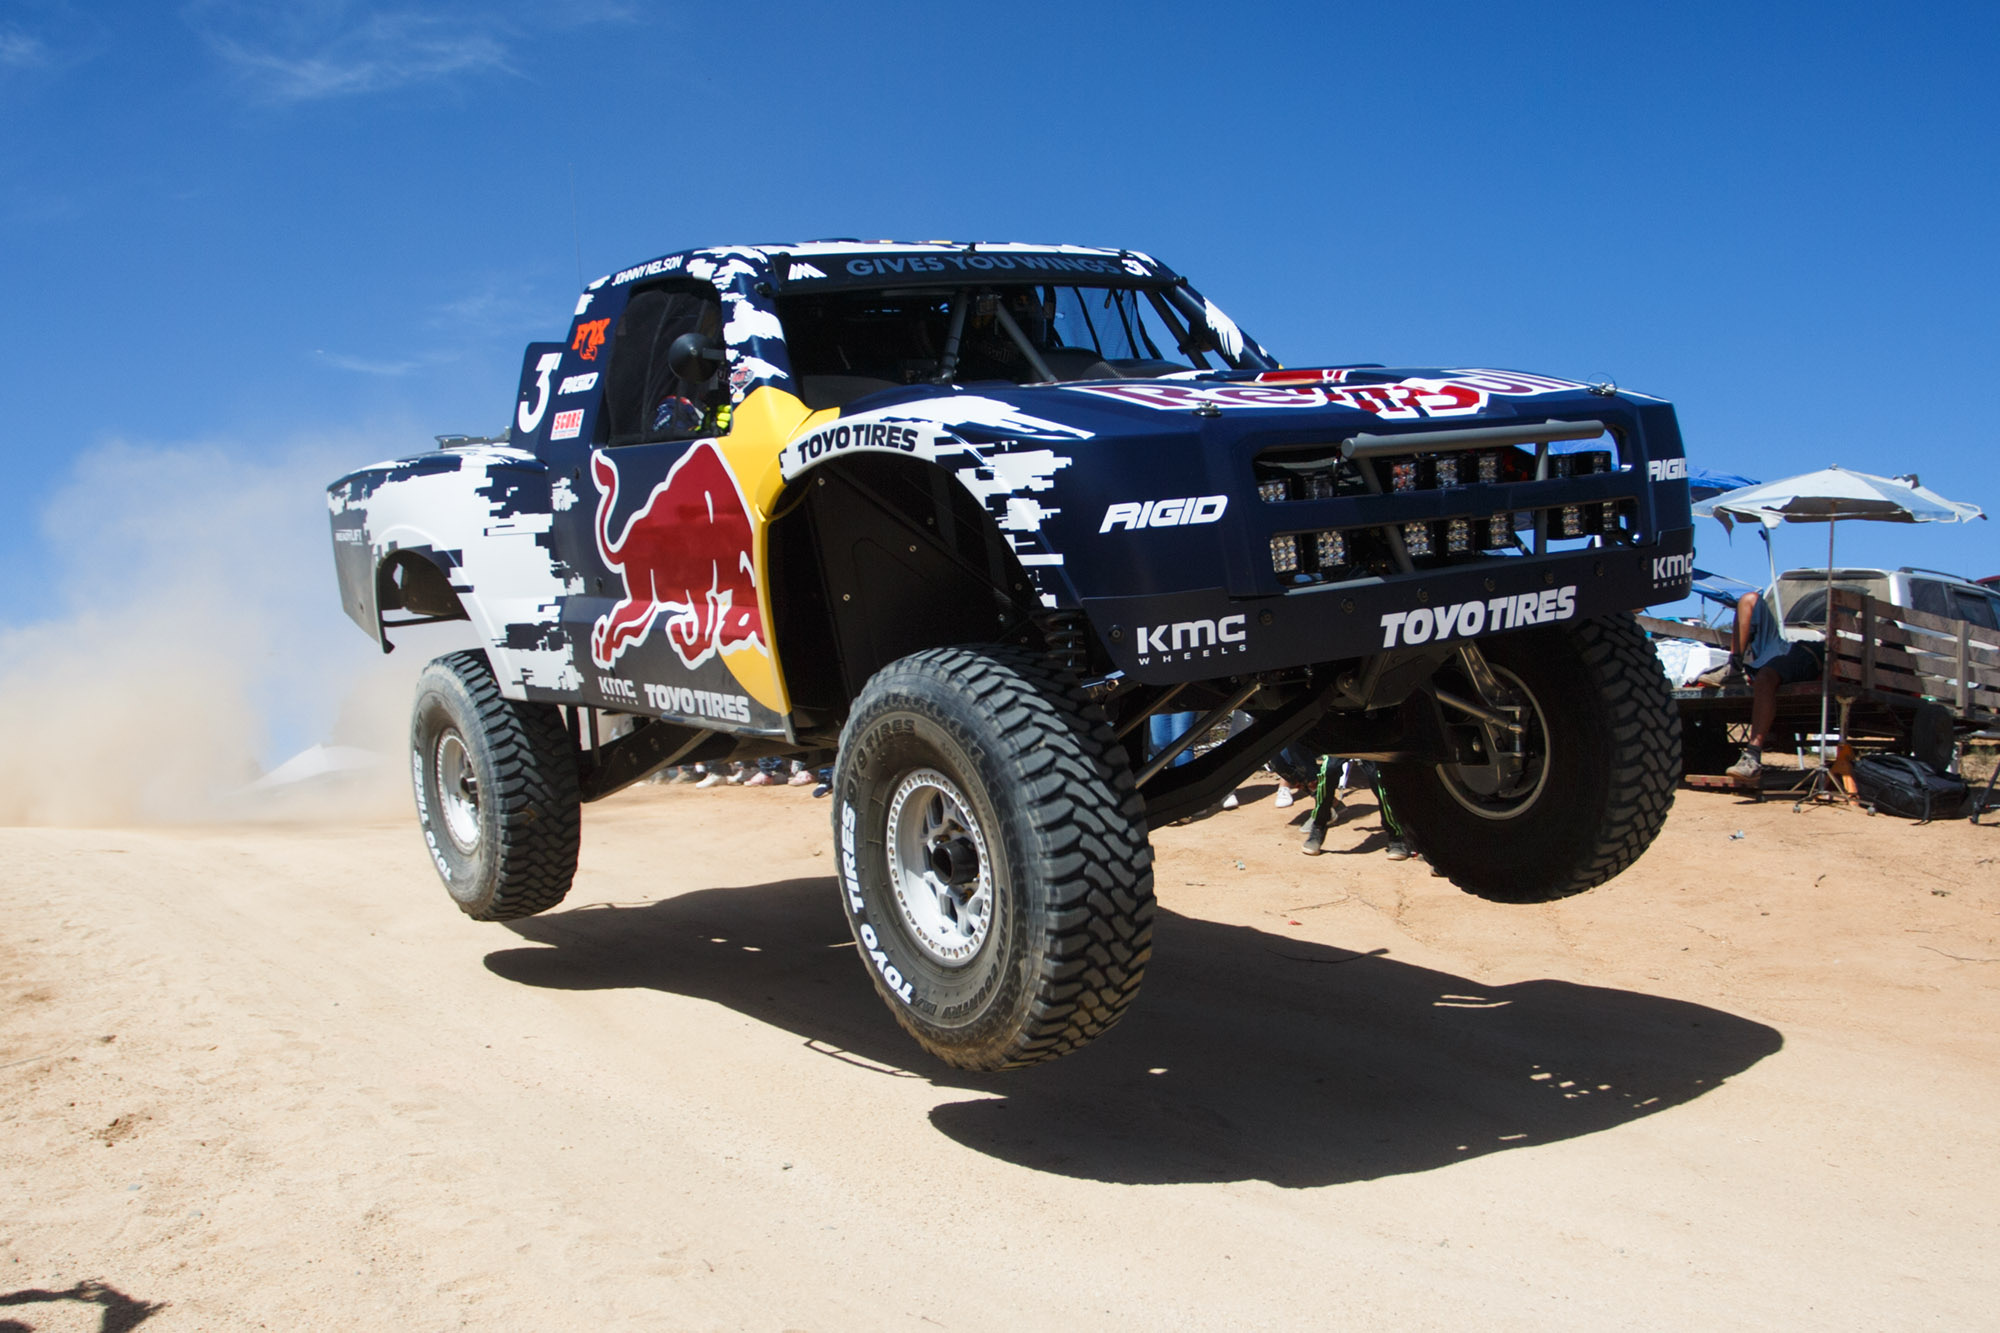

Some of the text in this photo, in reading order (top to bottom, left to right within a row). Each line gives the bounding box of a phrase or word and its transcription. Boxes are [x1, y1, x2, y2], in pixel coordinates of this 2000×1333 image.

[611, 255, 684, 286] JOHNNY NELSON
[846, 255, 1122, 276] GIVES YOU WINGS
[571, 317, 611, 361] FOX
[798, 423, 919, 465] TOYO TIRES
[1098, 494, 1229, 534] RIGID
[1380, 585, 1578, 649] TOYO TIRES
[1138, 643, 1247, 666] WHEELS
[643, 682, 751, 724] TOYO TIRES
[865, 719, 916, 753] TIRES
[412, 750, 452, 881] TOYO TIRES
[841, 800, 914, 1005] TOYO TIRES
